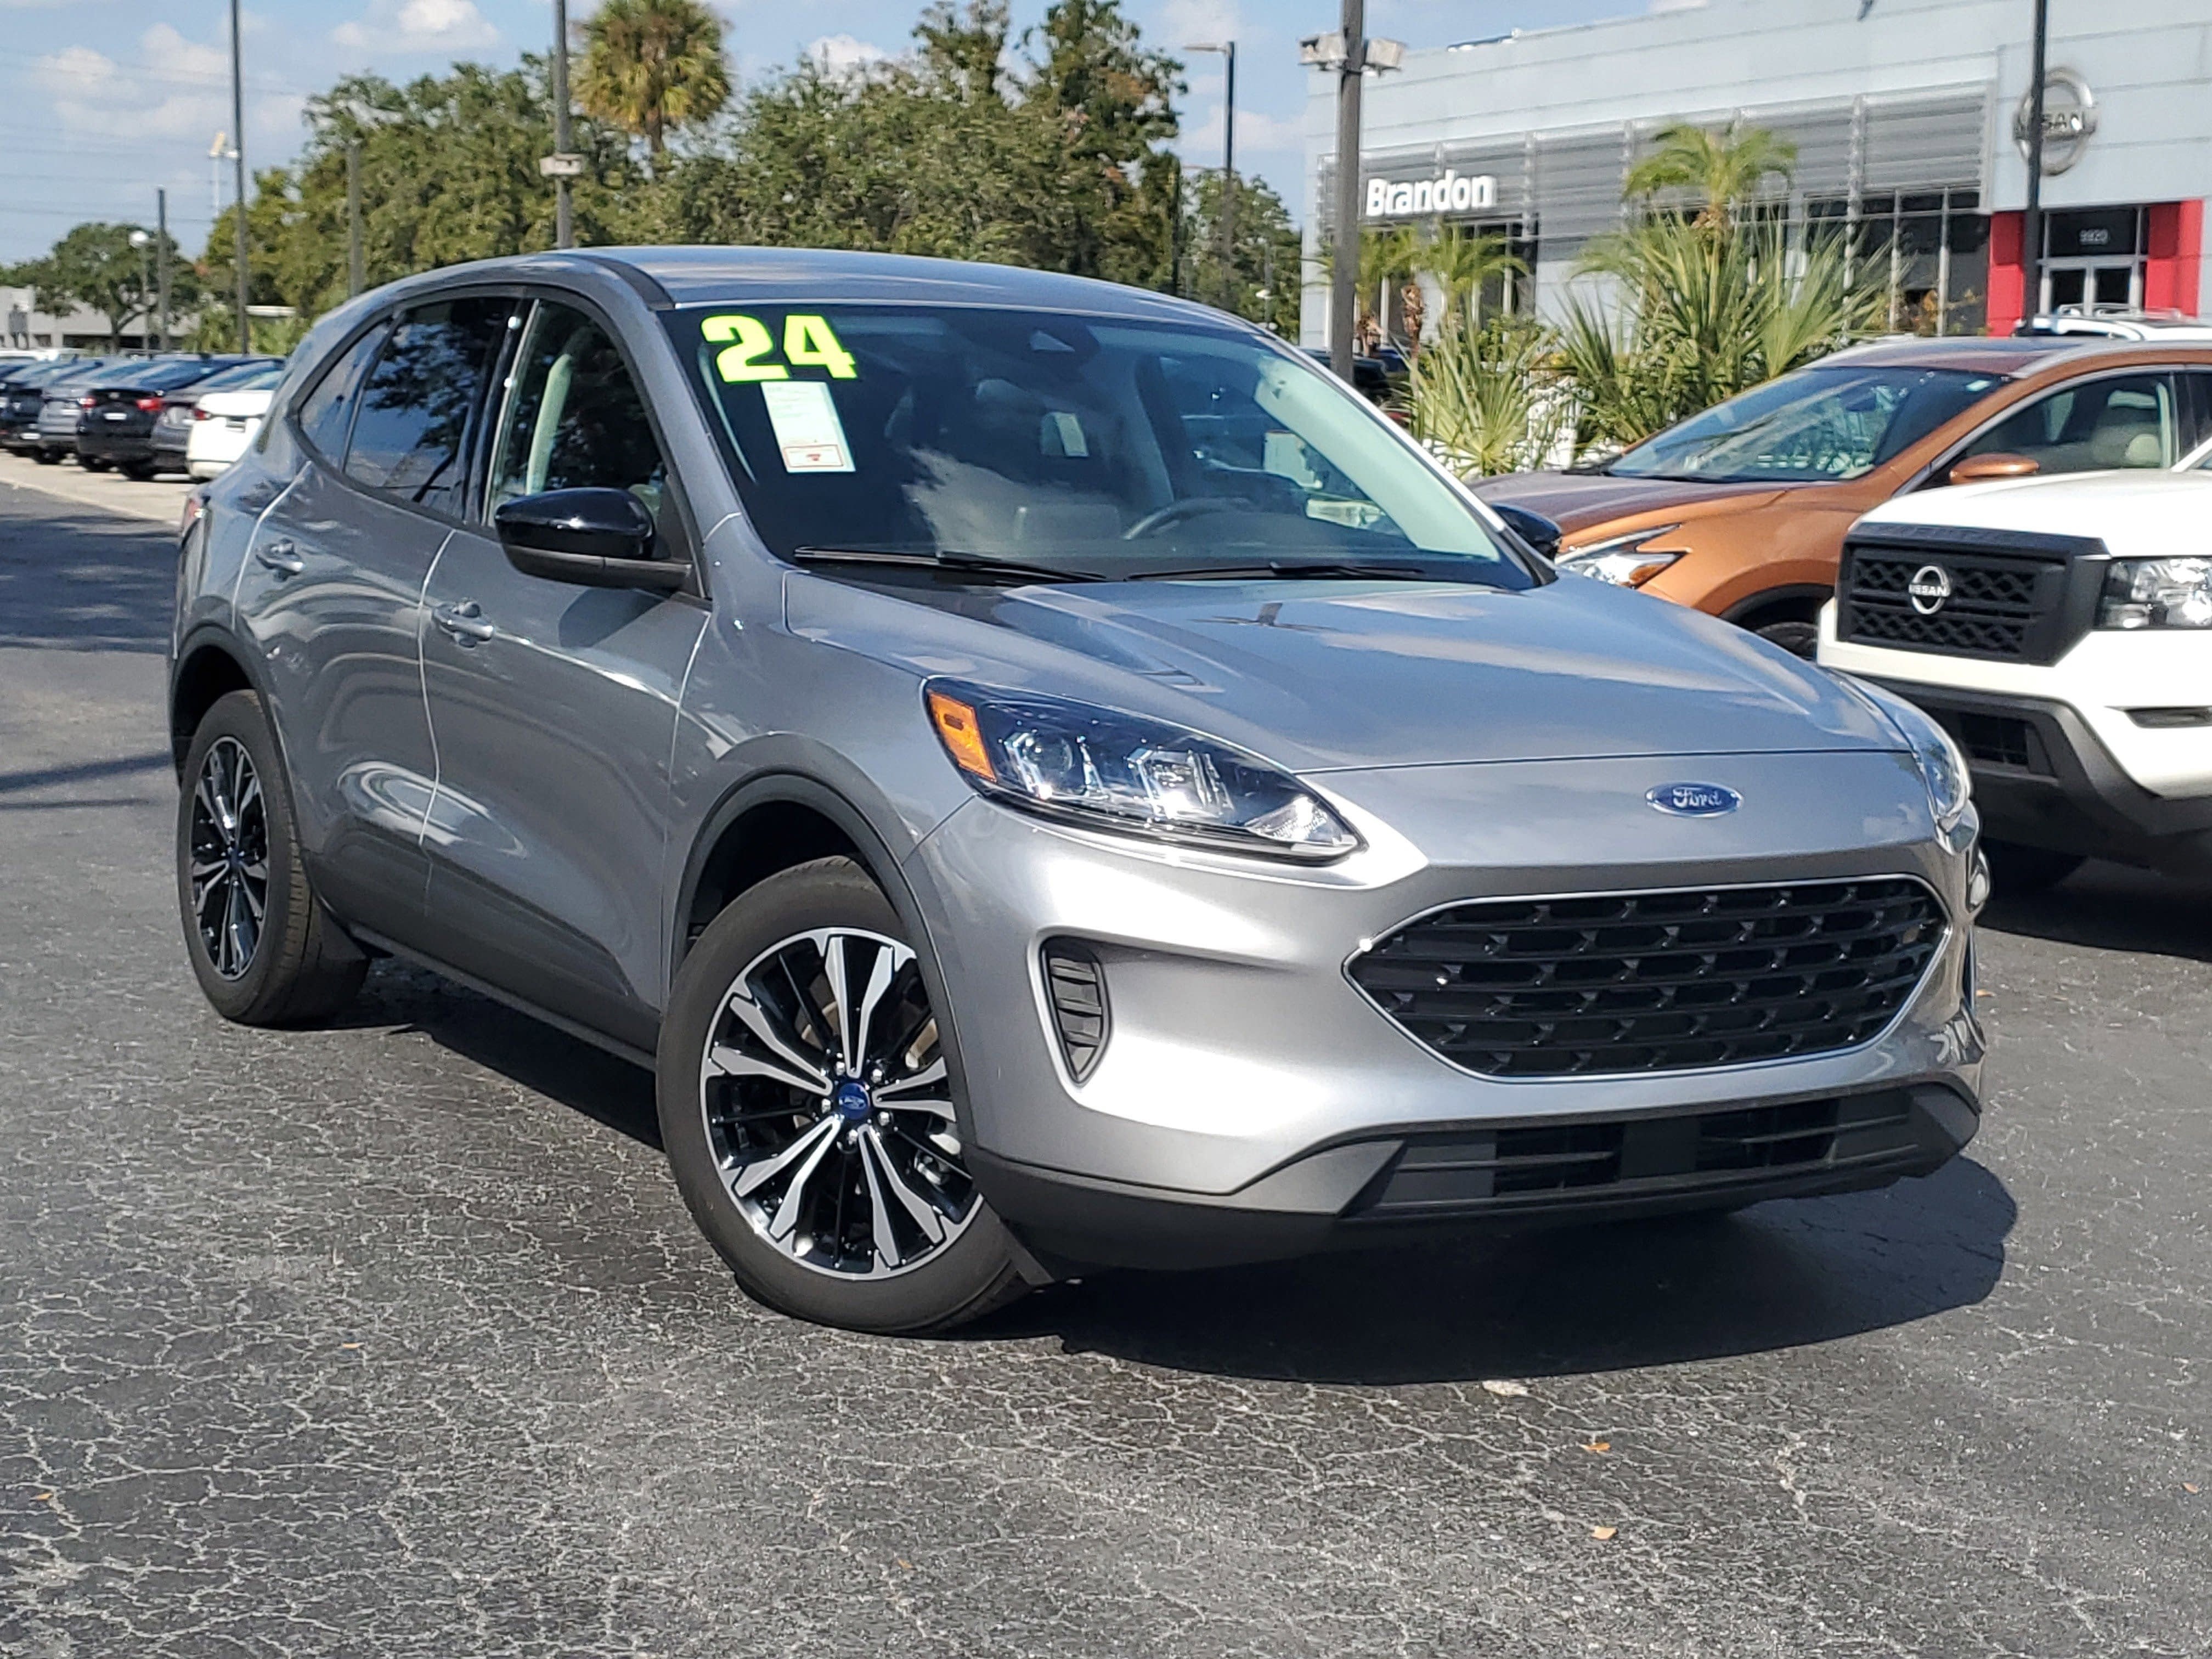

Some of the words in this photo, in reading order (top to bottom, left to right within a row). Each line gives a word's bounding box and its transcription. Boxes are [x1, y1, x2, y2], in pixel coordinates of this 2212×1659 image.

[1366, 169, 1497, 216] Brandon
[701, 314, 857, 382] 24
[1673, 787, 1722, 808] Ford
